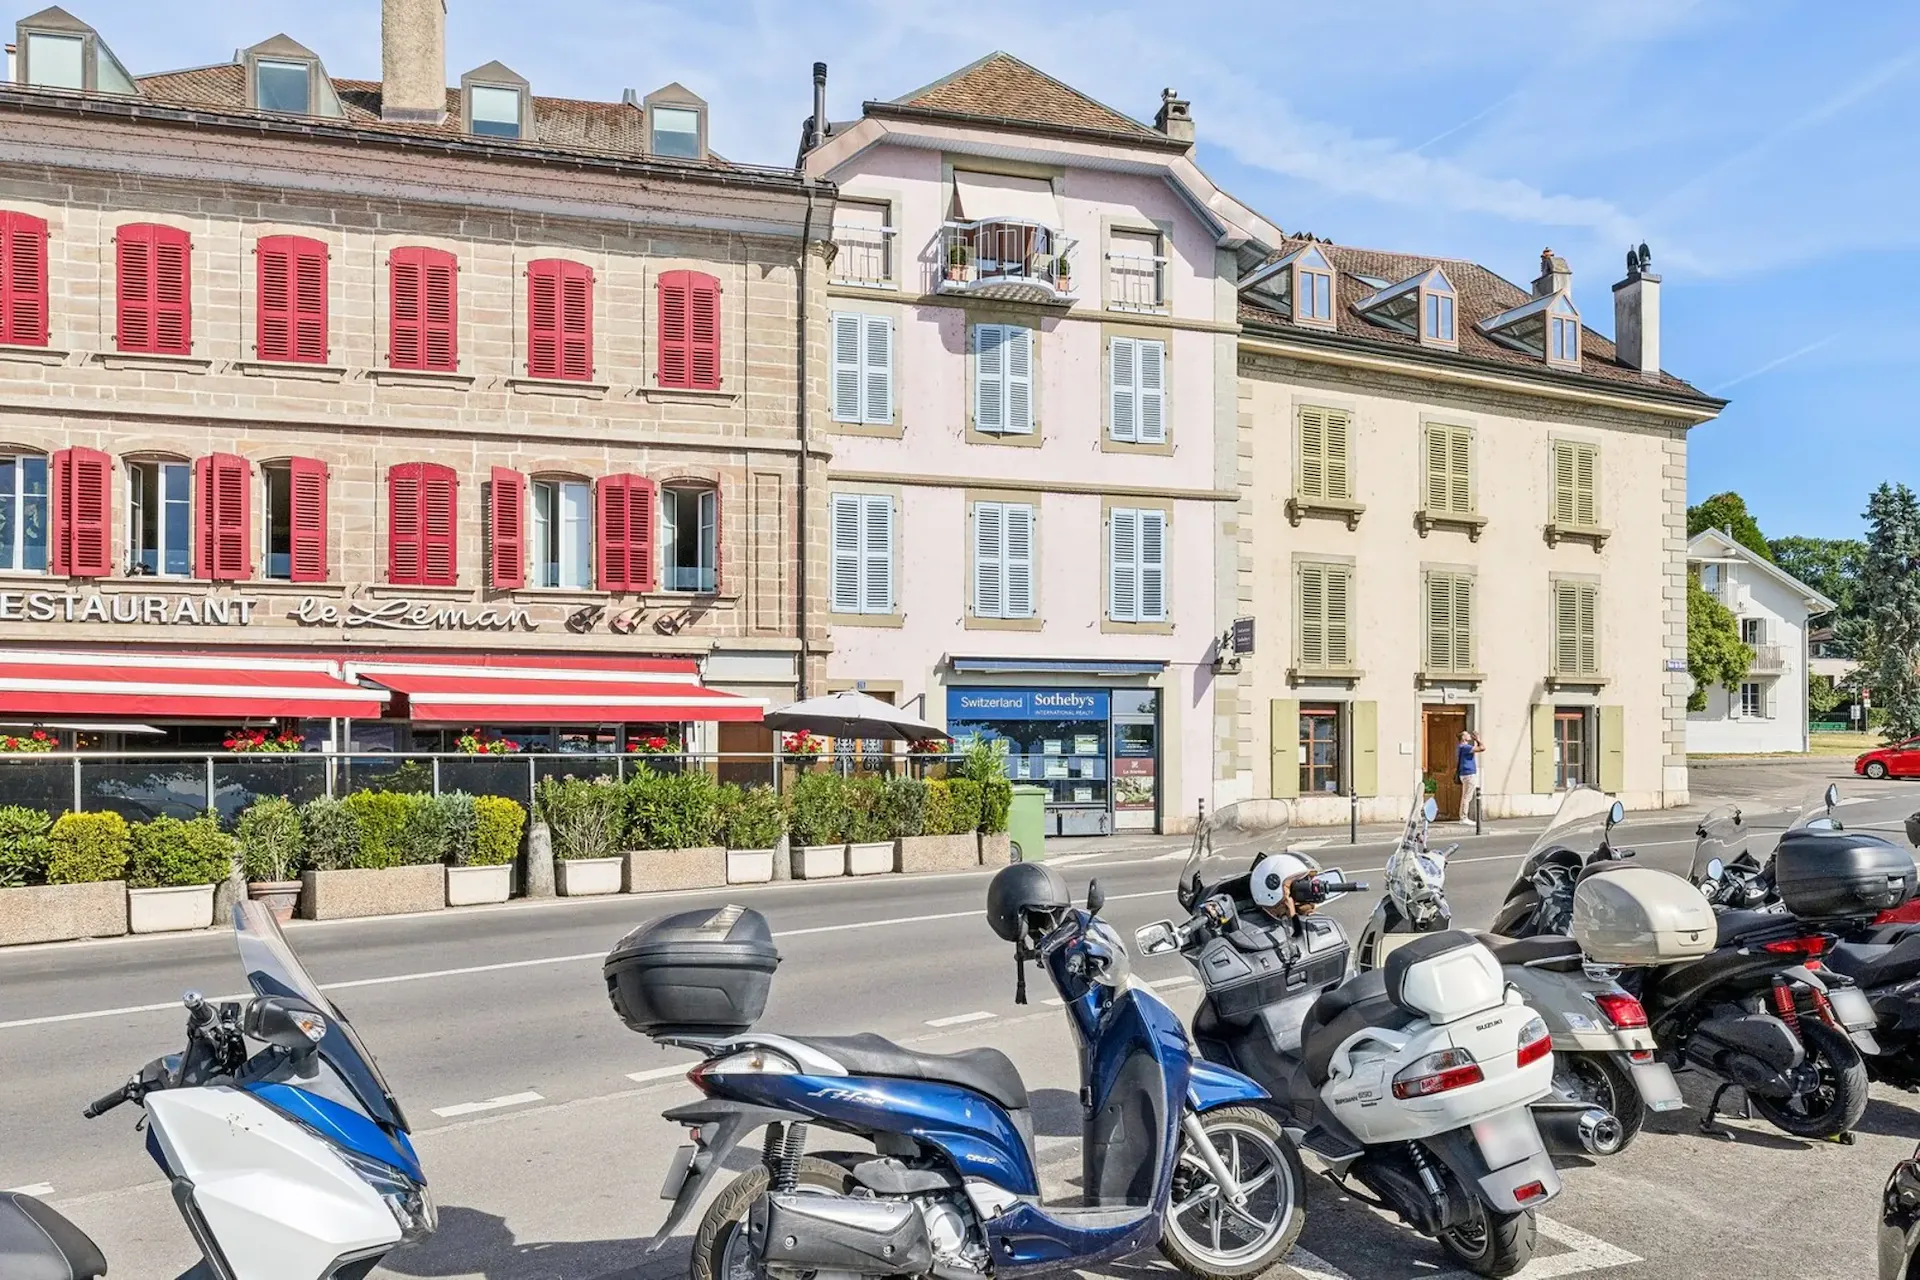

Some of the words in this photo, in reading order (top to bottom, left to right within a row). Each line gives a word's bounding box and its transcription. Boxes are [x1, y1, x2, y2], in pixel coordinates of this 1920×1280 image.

[0, 592, 257, 624] ESTAURANT
[288, 596, 338, 624] le
[961, 696, 1023, 708] Switzerland
[1034, 692, 1095, 708] Sotheby's
[1475, 1018, 1503, 1032] SUZUKI
